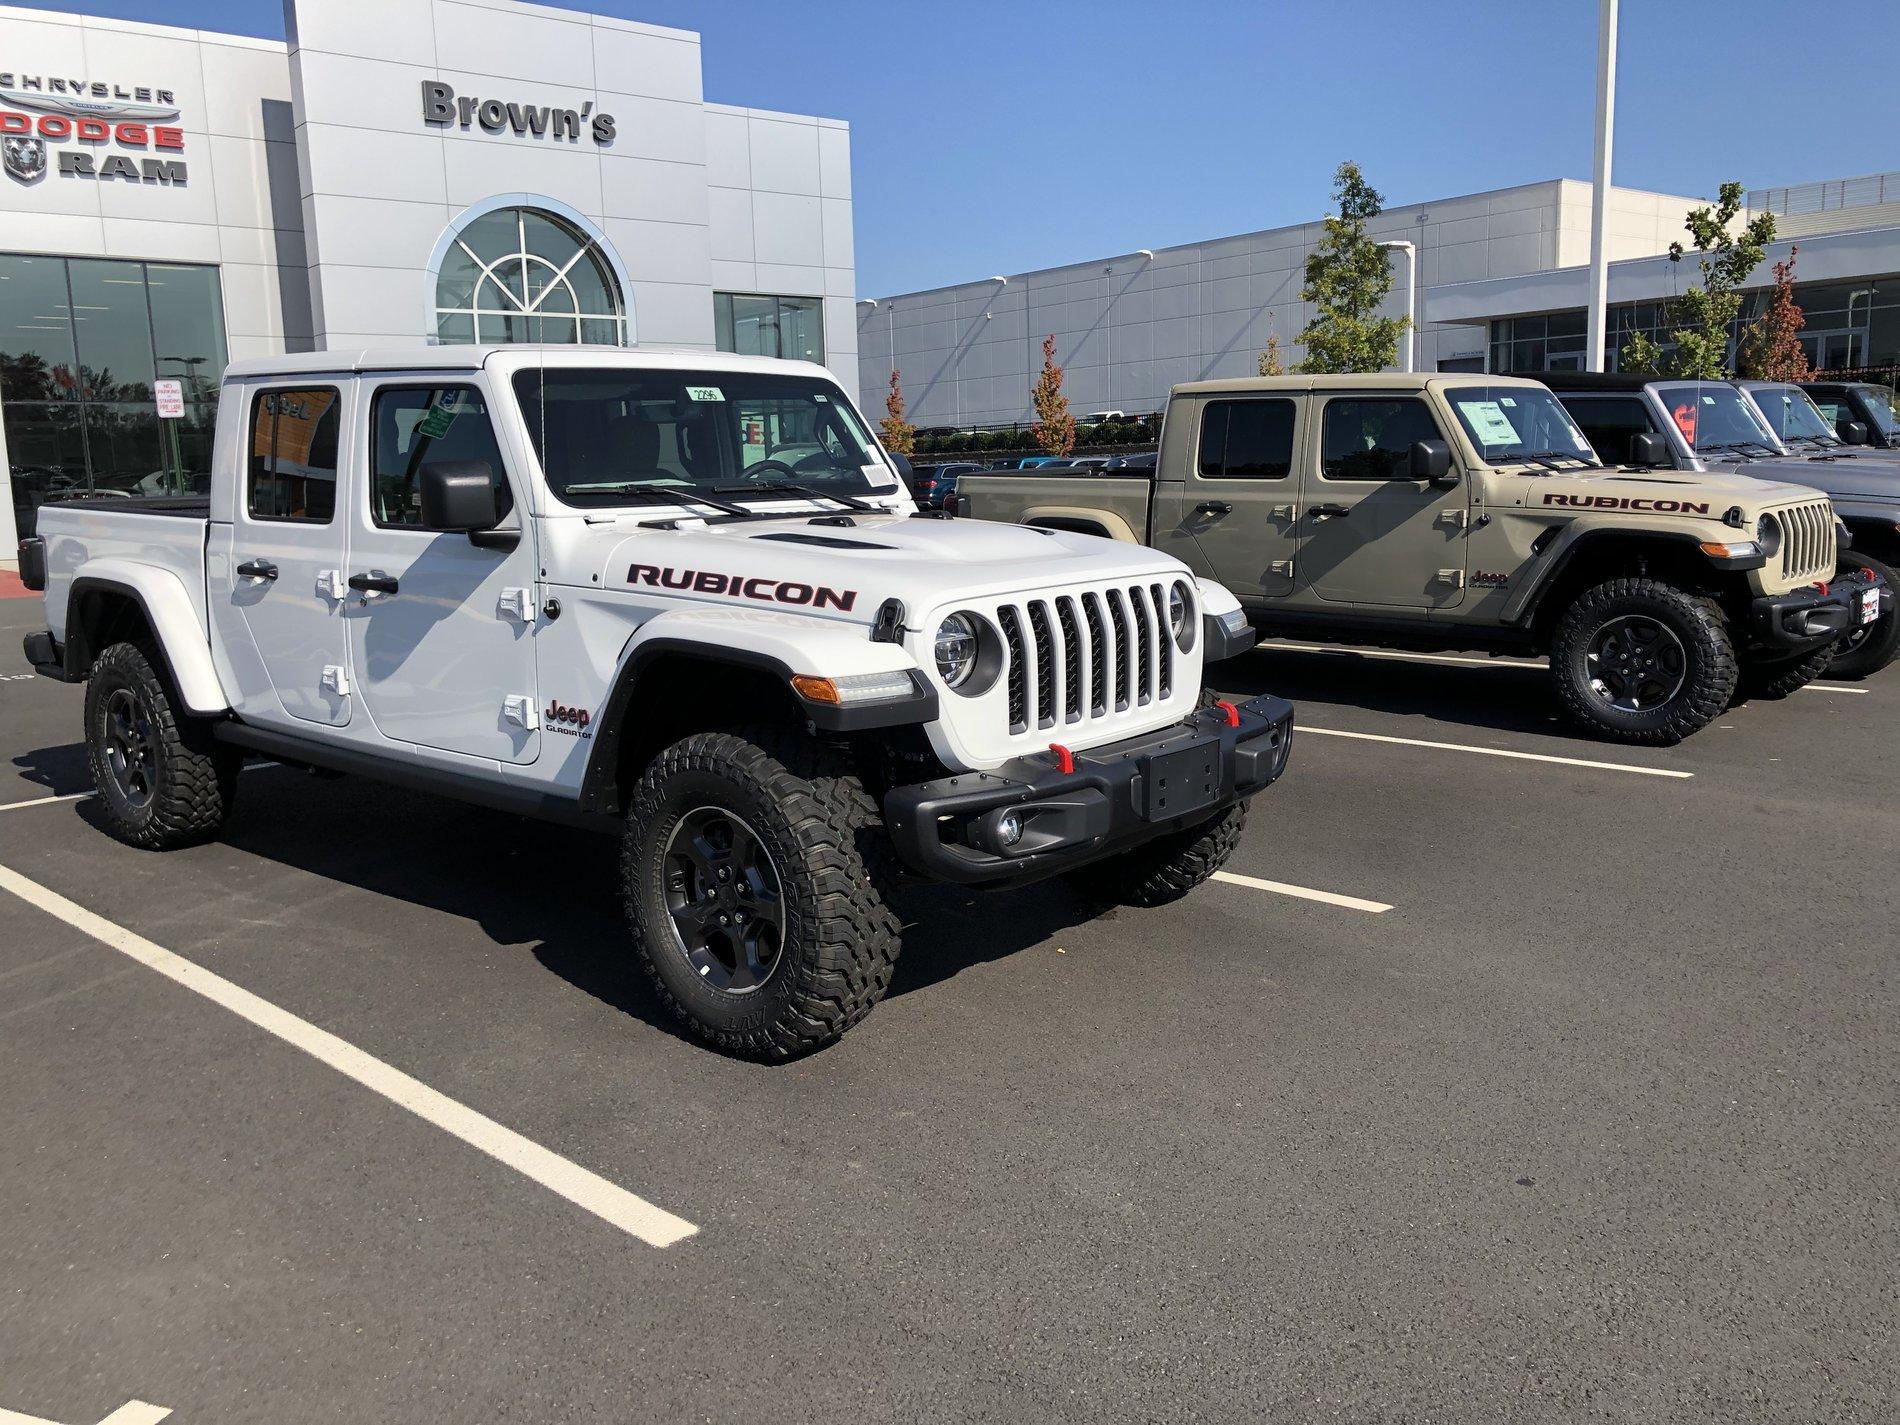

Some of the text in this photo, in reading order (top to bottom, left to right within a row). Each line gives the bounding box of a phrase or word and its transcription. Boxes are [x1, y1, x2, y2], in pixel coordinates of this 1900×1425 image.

[0, 72, 176, 105] CHRYSLER
[421, 80, 617, 141] Brown's
[0, 112, 185, 149] DODGE
[57, 151, 188, 182] RAM
[1543, 493, 1710, 514] RUBICON
[626, 563, 858, 612] RUBICON
[1470, 570, 1509, 584] Jeep
[545, 699, 590, 729] Jeep
